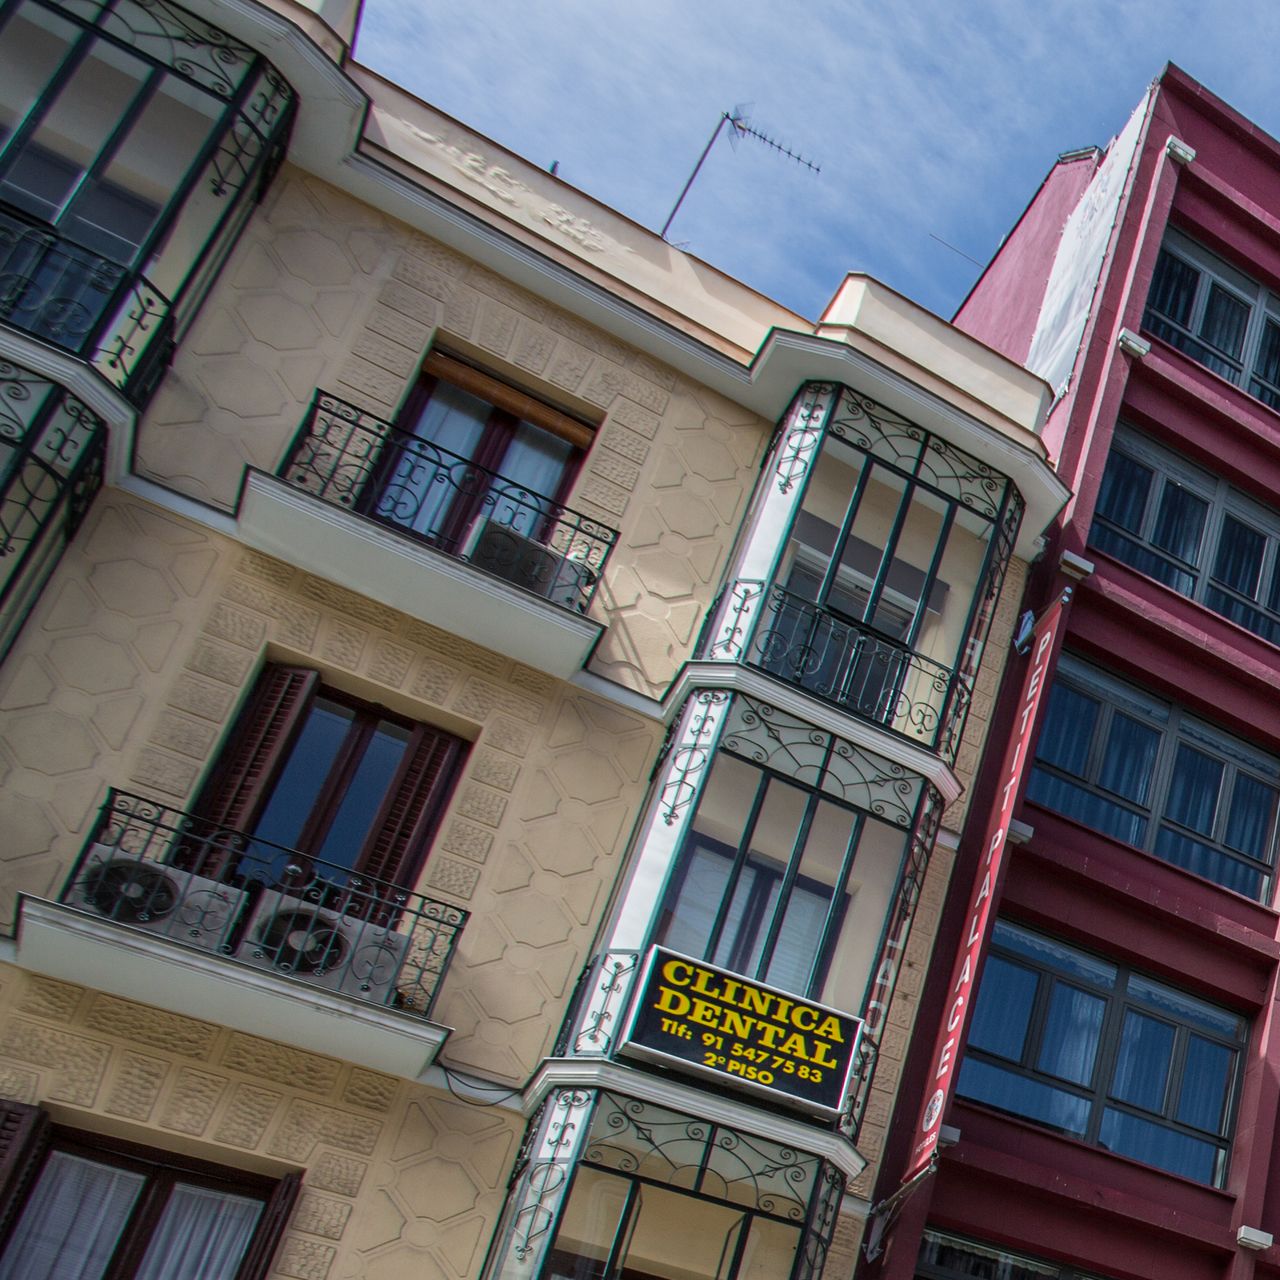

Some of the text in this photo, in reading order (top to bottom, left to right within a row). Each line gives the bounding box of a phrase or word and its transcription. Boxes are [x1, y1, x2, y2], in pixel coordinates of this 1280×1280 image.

[936, 631, 1051, 1080] PETIT PALACE
[654, 986, 837, 1069] DENTAL
[660, 1017, 692, 1040] Tlf:
[702, 1032, 723, 1051] 91
[662, 960, 844, 1043] CLINICA
[727, 1059, 774, 1085] PISO
